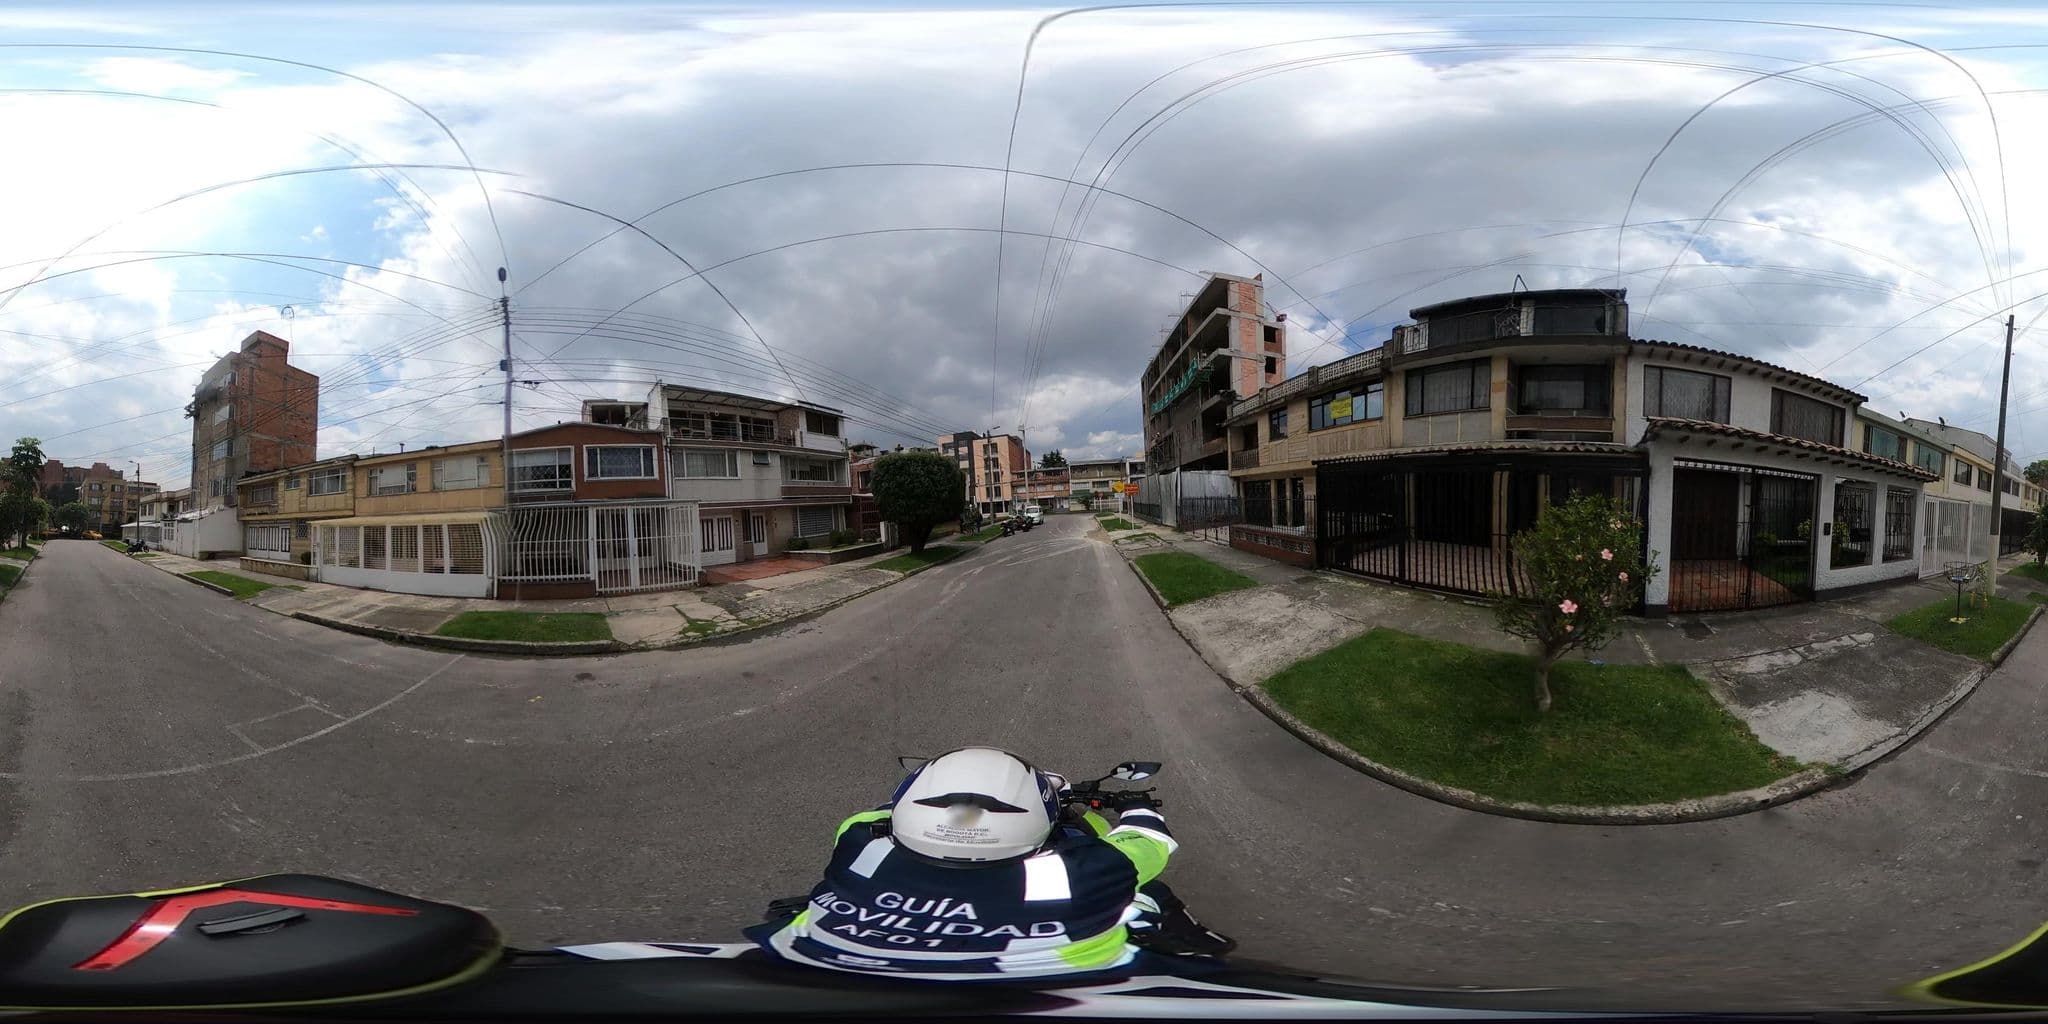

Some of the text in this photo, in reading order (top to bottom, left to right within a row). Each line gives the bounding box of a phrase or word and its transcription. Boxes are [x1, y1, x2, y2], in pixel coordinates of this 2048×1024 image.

[815, 892, 1066, 937] MOVILIDAD
[874, 892, 978, 920] GUÍA
[832, 923, 944, 948] AF01
